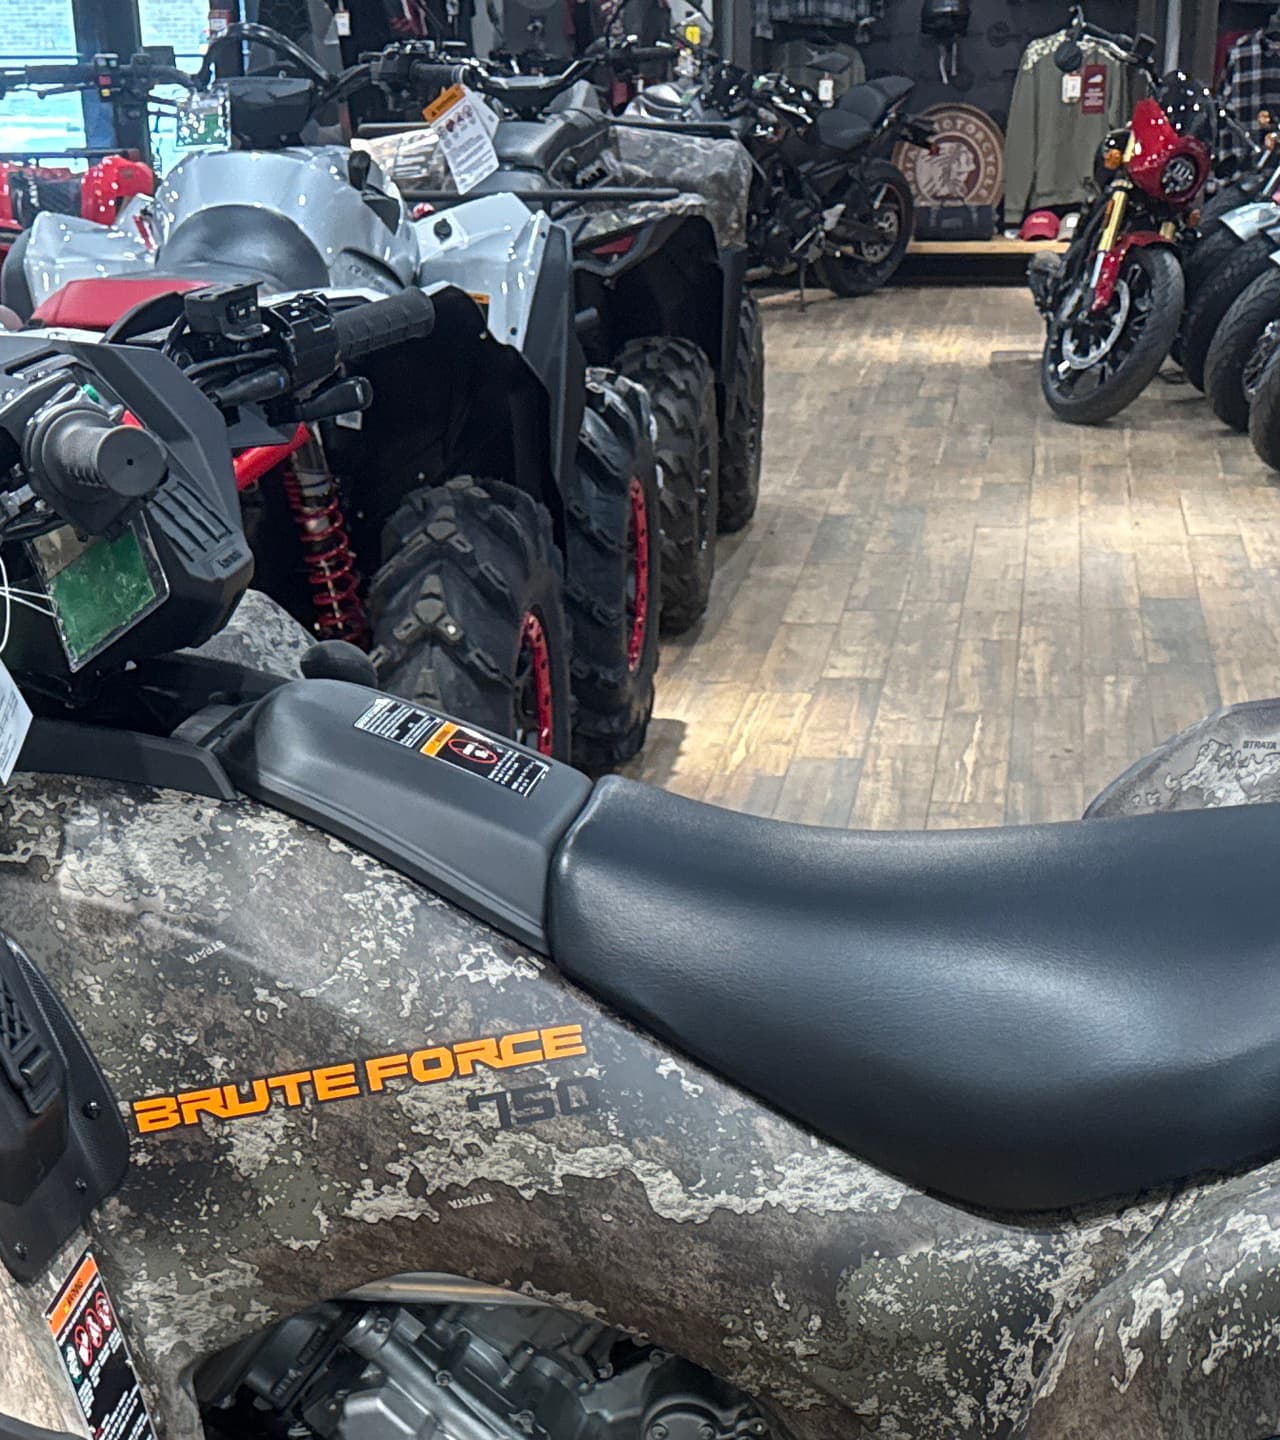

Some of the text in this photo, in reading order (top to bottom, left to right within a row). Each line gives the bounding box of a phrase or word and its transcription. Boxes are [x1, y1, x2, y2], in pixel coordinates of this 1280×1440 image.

[183, 940, 227, 966] STRATA
[132, 1023, 588, 1135] BRUTE FORCE
[466, 1075, 602, 1130] 750
[447, 1193, 493, 1209] STRATA
